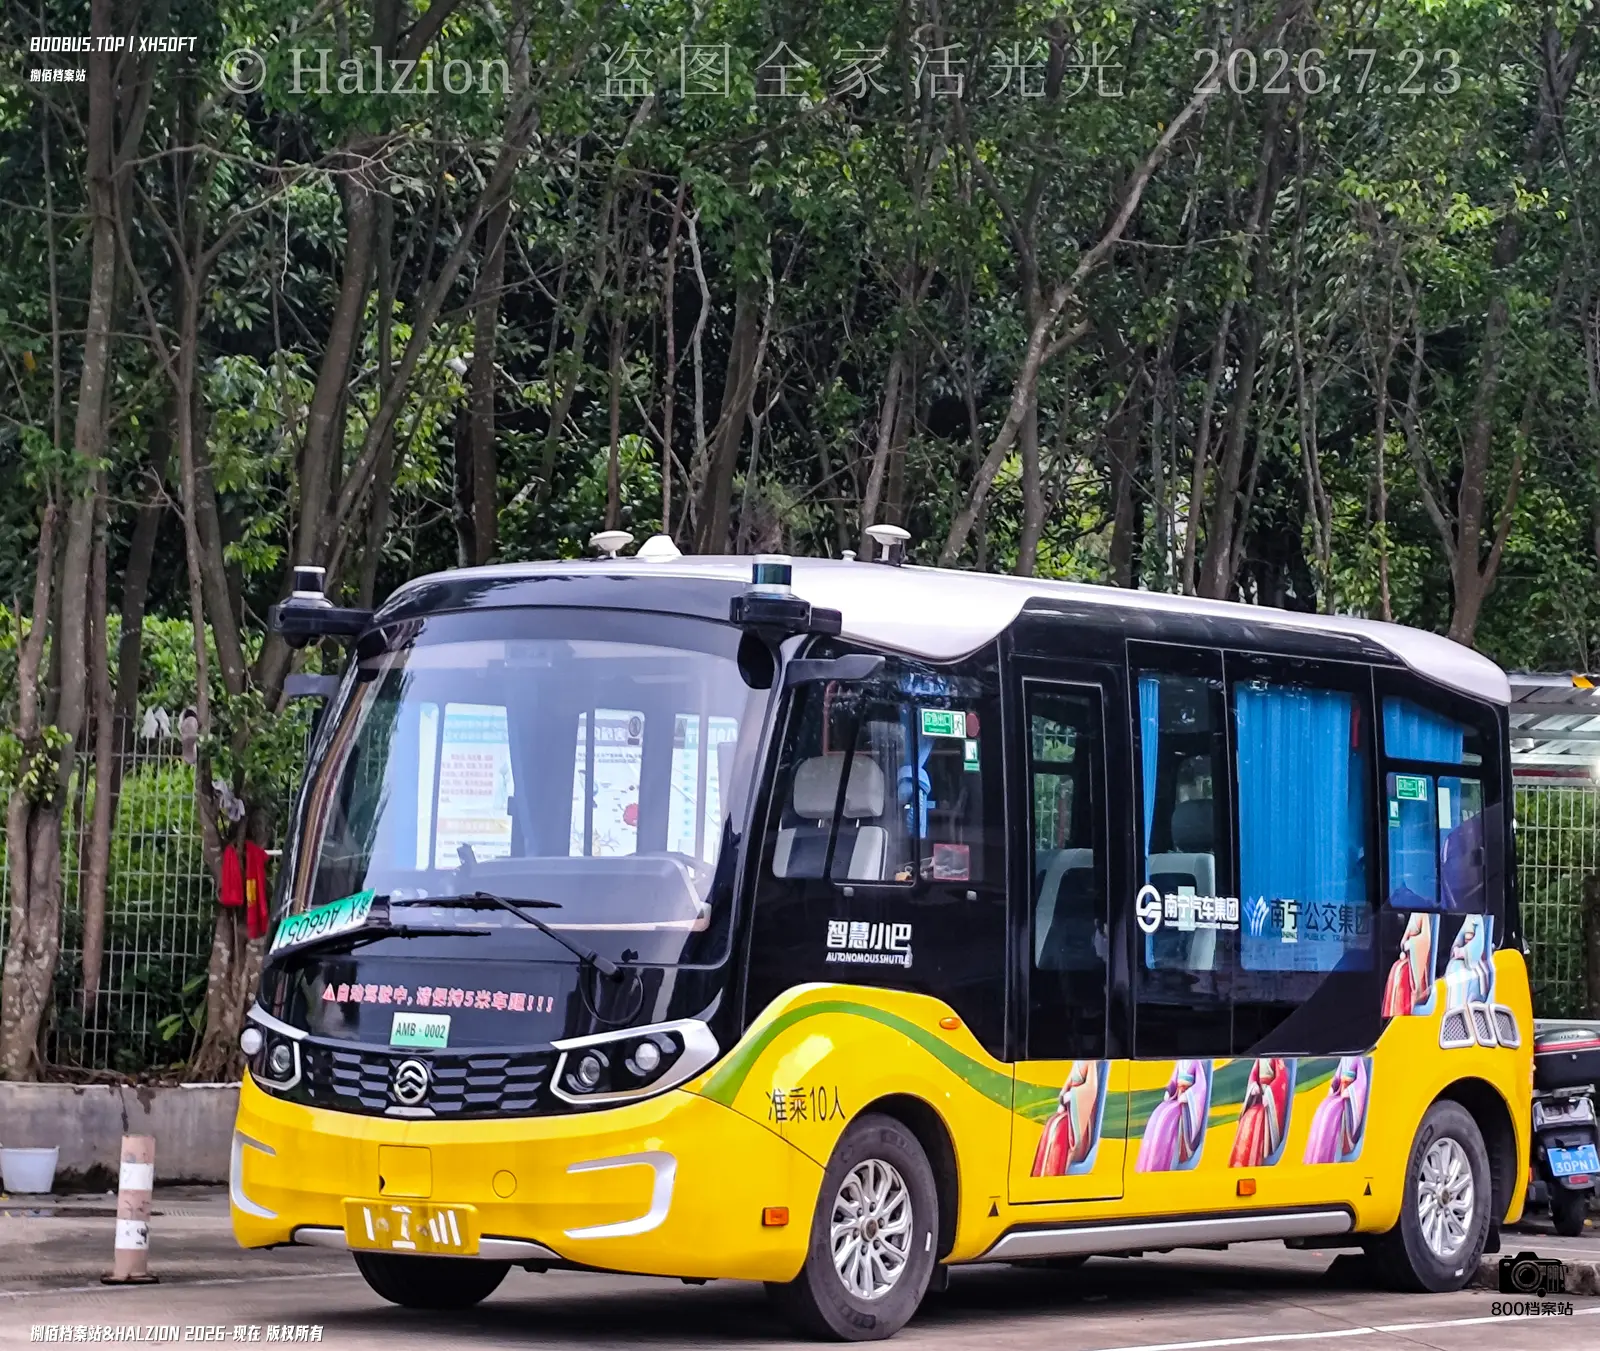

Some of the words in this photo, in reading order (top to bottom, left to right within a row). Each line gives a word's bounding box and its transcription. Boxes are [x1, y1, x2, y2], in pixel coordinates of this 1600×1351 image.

[1164, 893, 1239, 921] 南宁汽车集团
[1270, 897, 1370, 936] 南宁公交集团
[826, 919, 912, 951] 智慧小巴
[765, 1085, 846, 1124] 准乘10人
